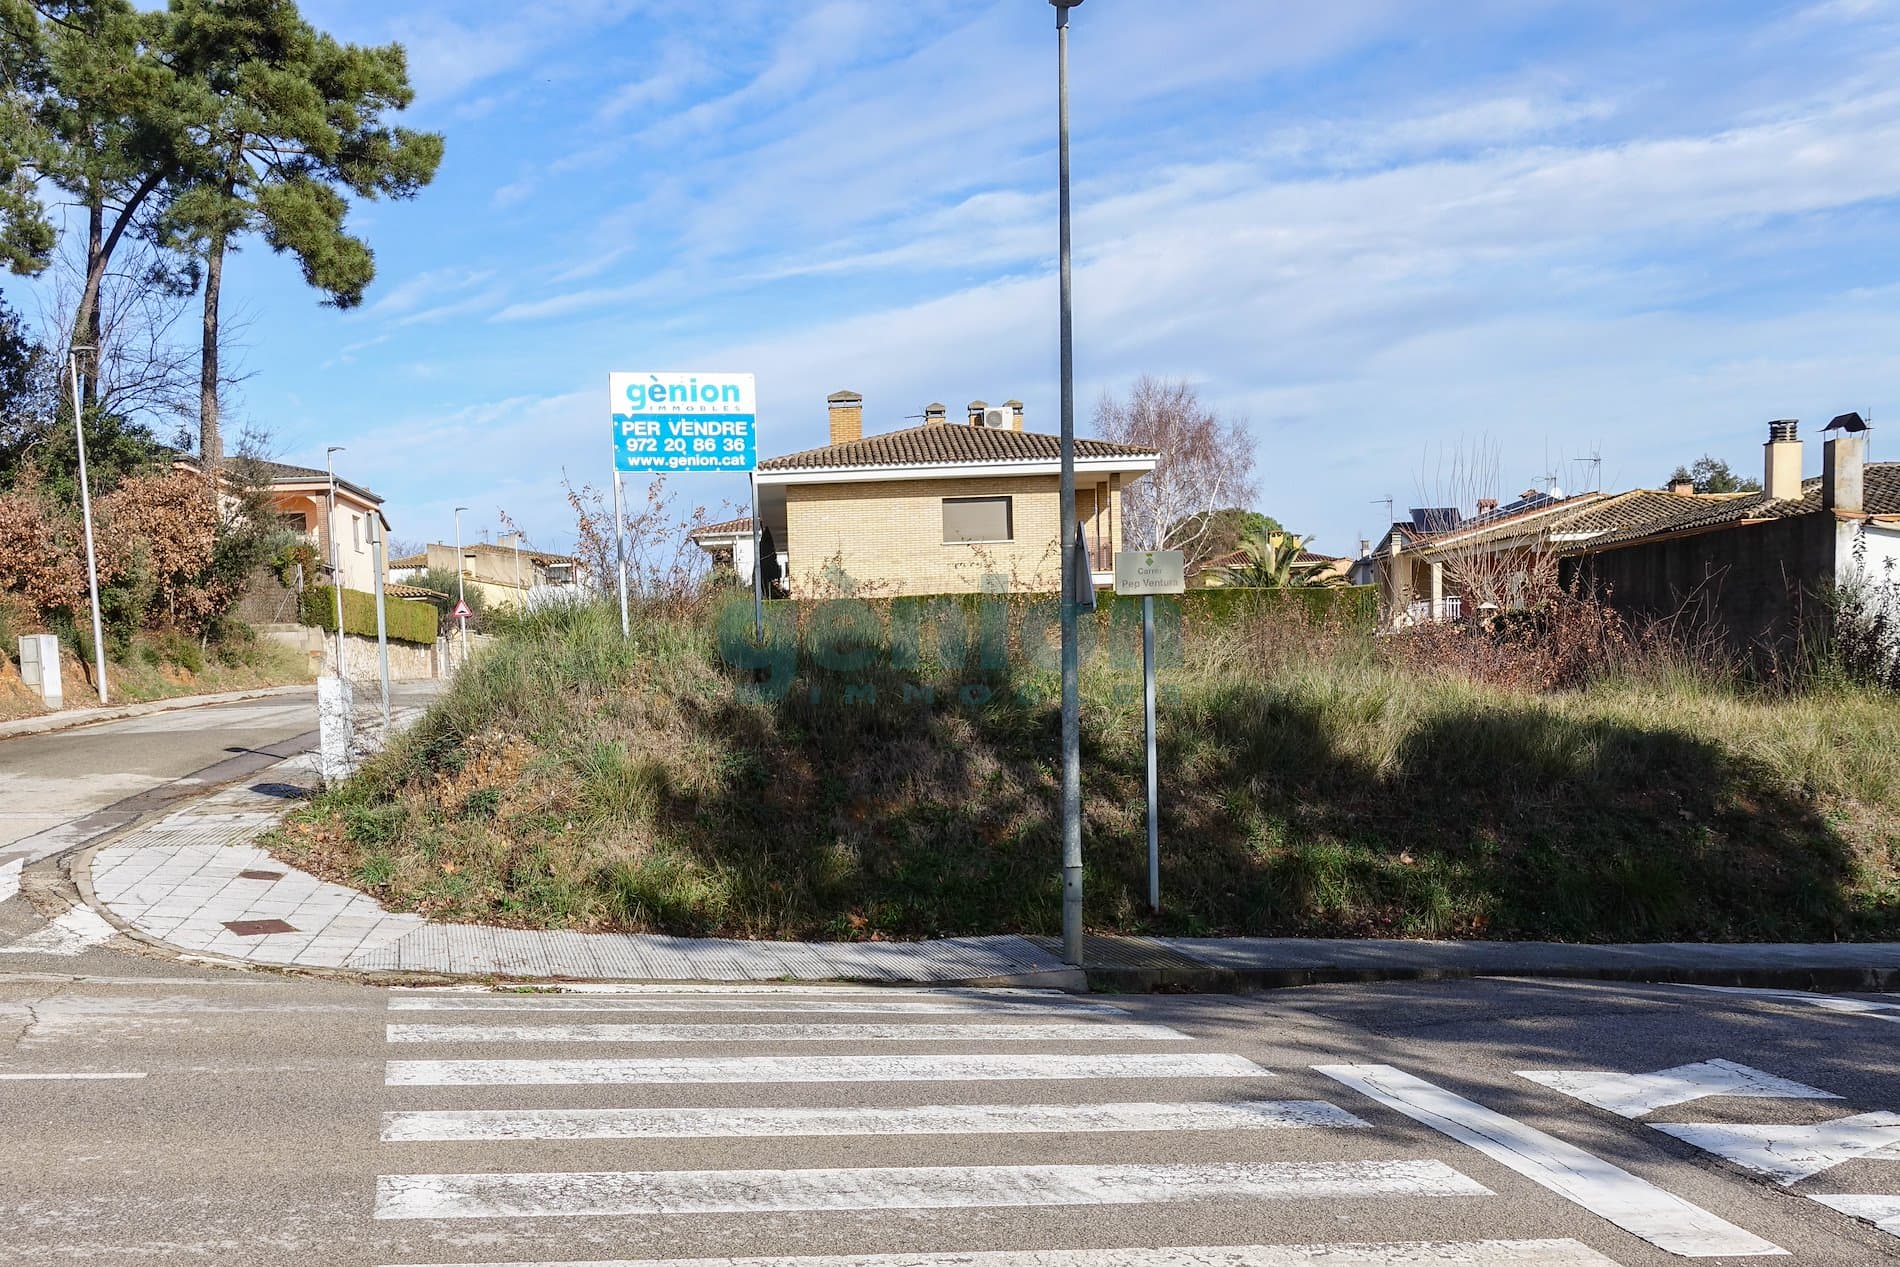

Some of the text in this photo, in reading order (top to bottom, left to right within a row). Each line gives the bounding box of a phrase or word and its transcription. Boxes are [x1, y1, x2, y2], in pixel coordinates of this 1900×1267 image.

[626, 375, 740, 411] gènion
[622, 421, 748, 436] PER VENDRE
[626, 438, 745, 452] 972 20 86 36
[1122, 579, 1179, 589] Pep Ventura
